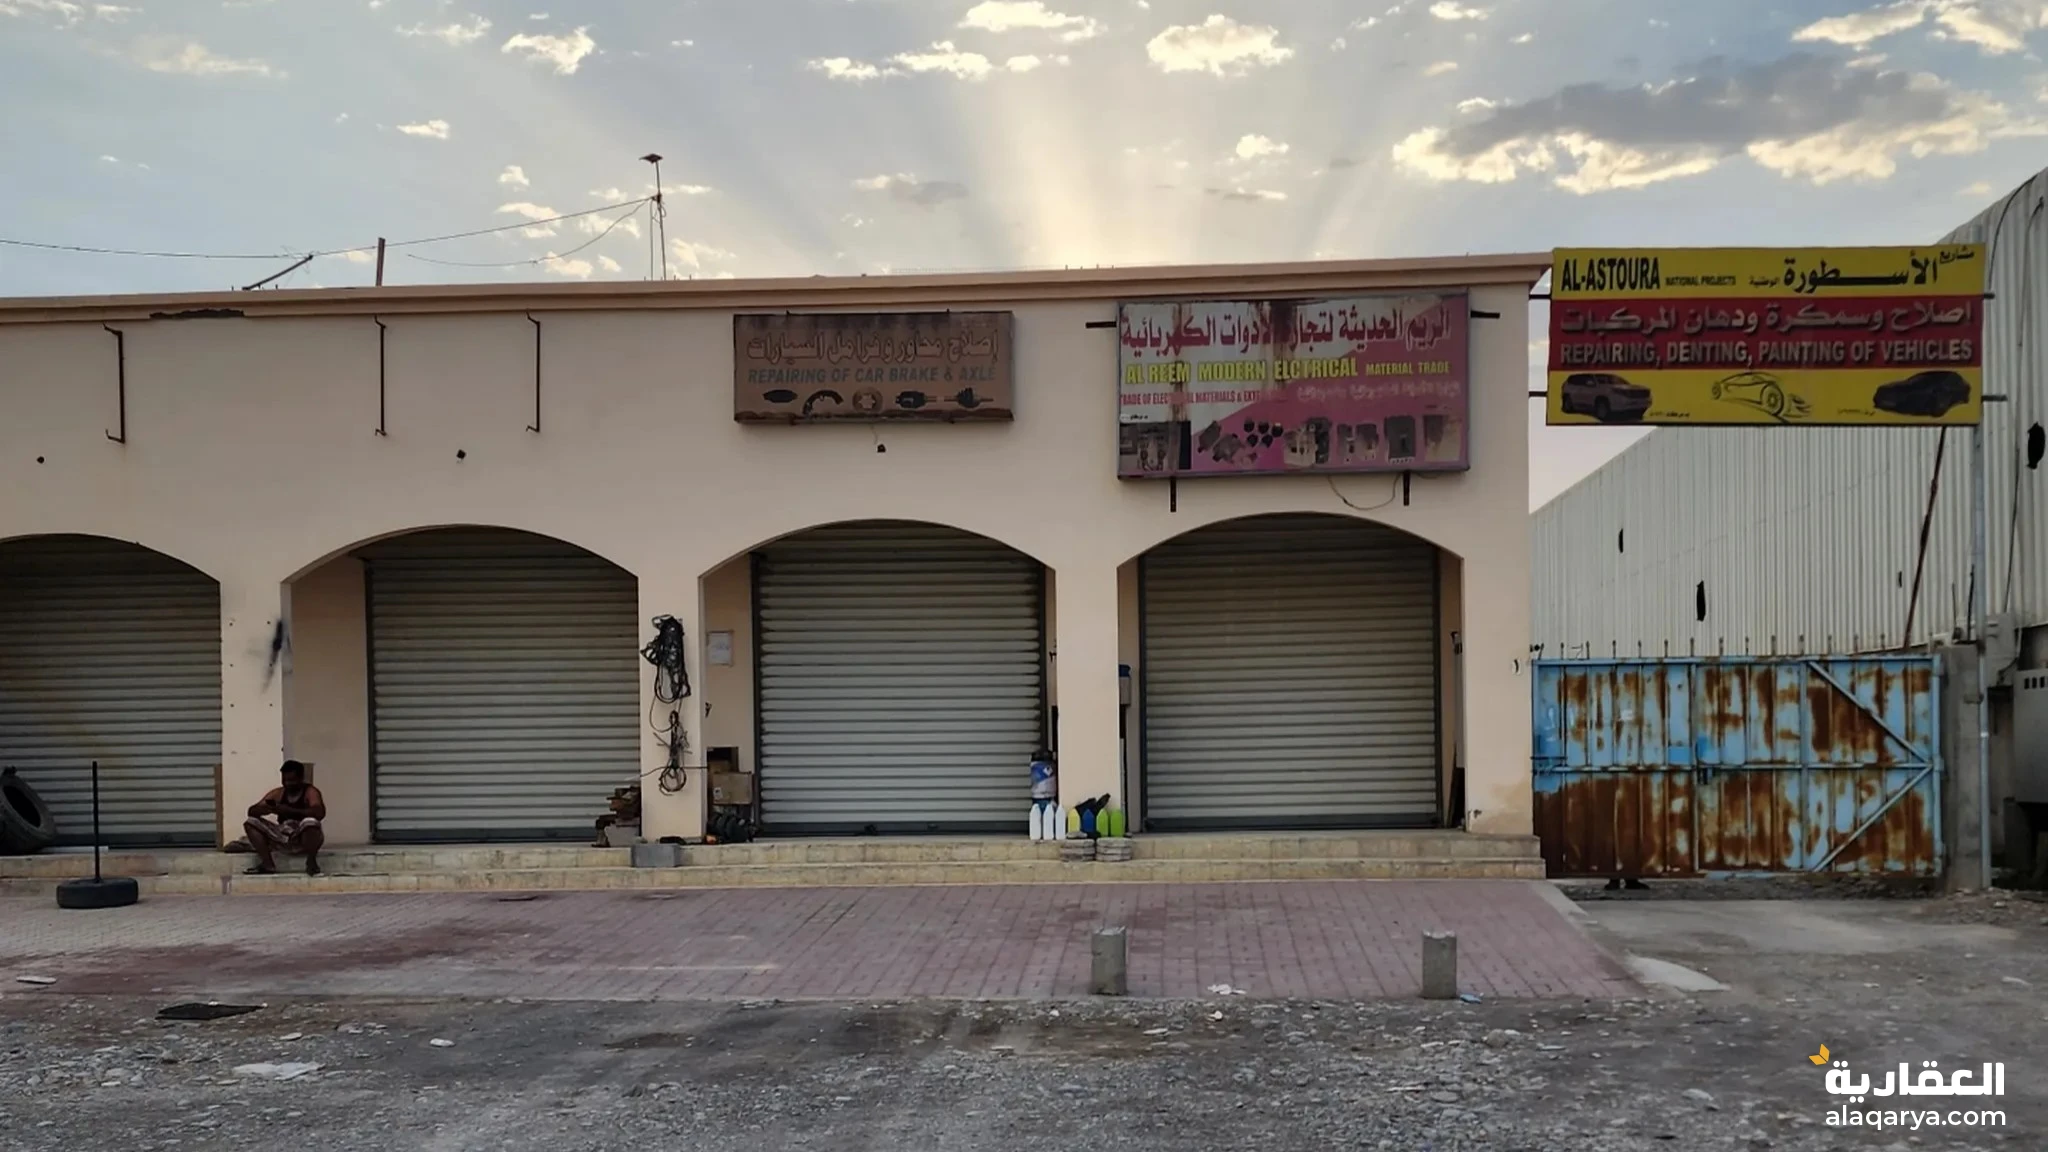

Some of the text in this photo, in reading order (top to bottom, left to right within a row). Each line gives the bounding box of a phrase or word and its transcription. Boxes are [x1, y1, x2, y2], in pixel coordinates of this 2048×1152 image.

[1560, 257, 1660, 291] AL-ASTOURA
[1339, 304, 1403, 351] الحديثة
[1406, 303, 1451, 351] الريم
[1561, 304, 1676, 337] المركبات
[1684, 305, 1758, 334] ودهان
[1766, 302, 1883, 332] وسمكرة
[747, 331, 825, 365] السيارات
[1121, 314, 1216, 358] الكهربائية
[1561, 339, 1973, 368] REPAIRING, DENTING, PAINTING OF VEHICLES
[748, 368, 827, 384] REPAIRING
[831, 367, 851, 382] OF
[855, 367, 884, 383] CAR
[889, 366, 939, 382] BRAKE
[959, 366, 997, 381] AXLE
[1126, 357, 1451, 384] AL REEM MODERN ELCTRICAL MATERIAL TRADE
